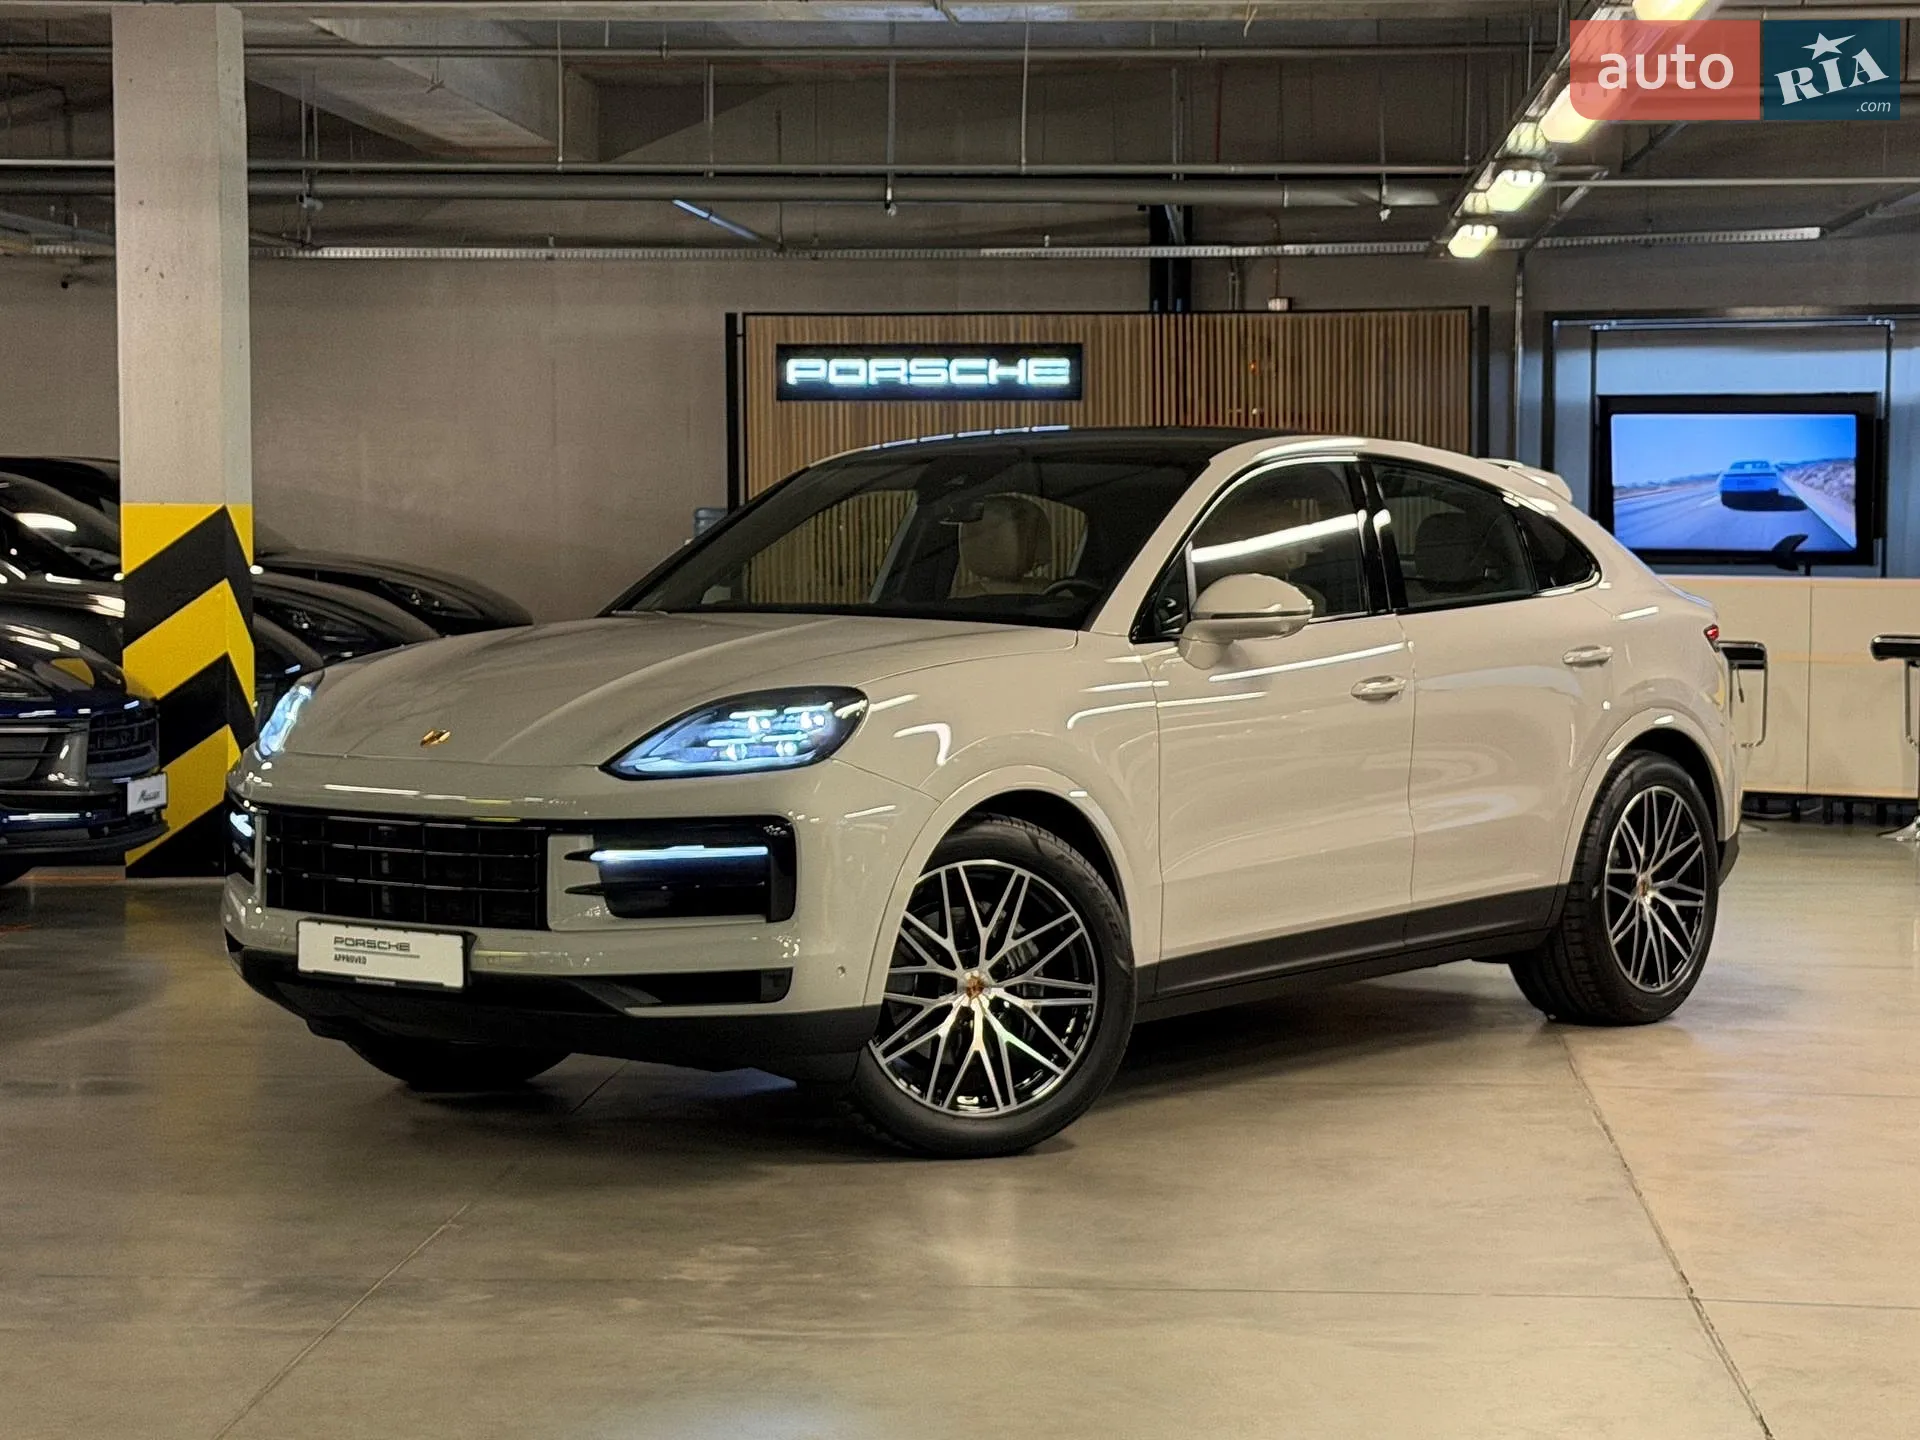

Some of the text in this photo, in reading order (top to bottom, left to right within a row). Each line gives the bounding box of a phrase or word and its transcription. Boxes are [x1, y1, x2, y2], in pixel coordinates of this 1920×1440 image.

[786, 358, 1071, 386] PORSCHE
[333, 936, 411, 952] PORSCHE
[333, 953, 367, 965] APPROVED
